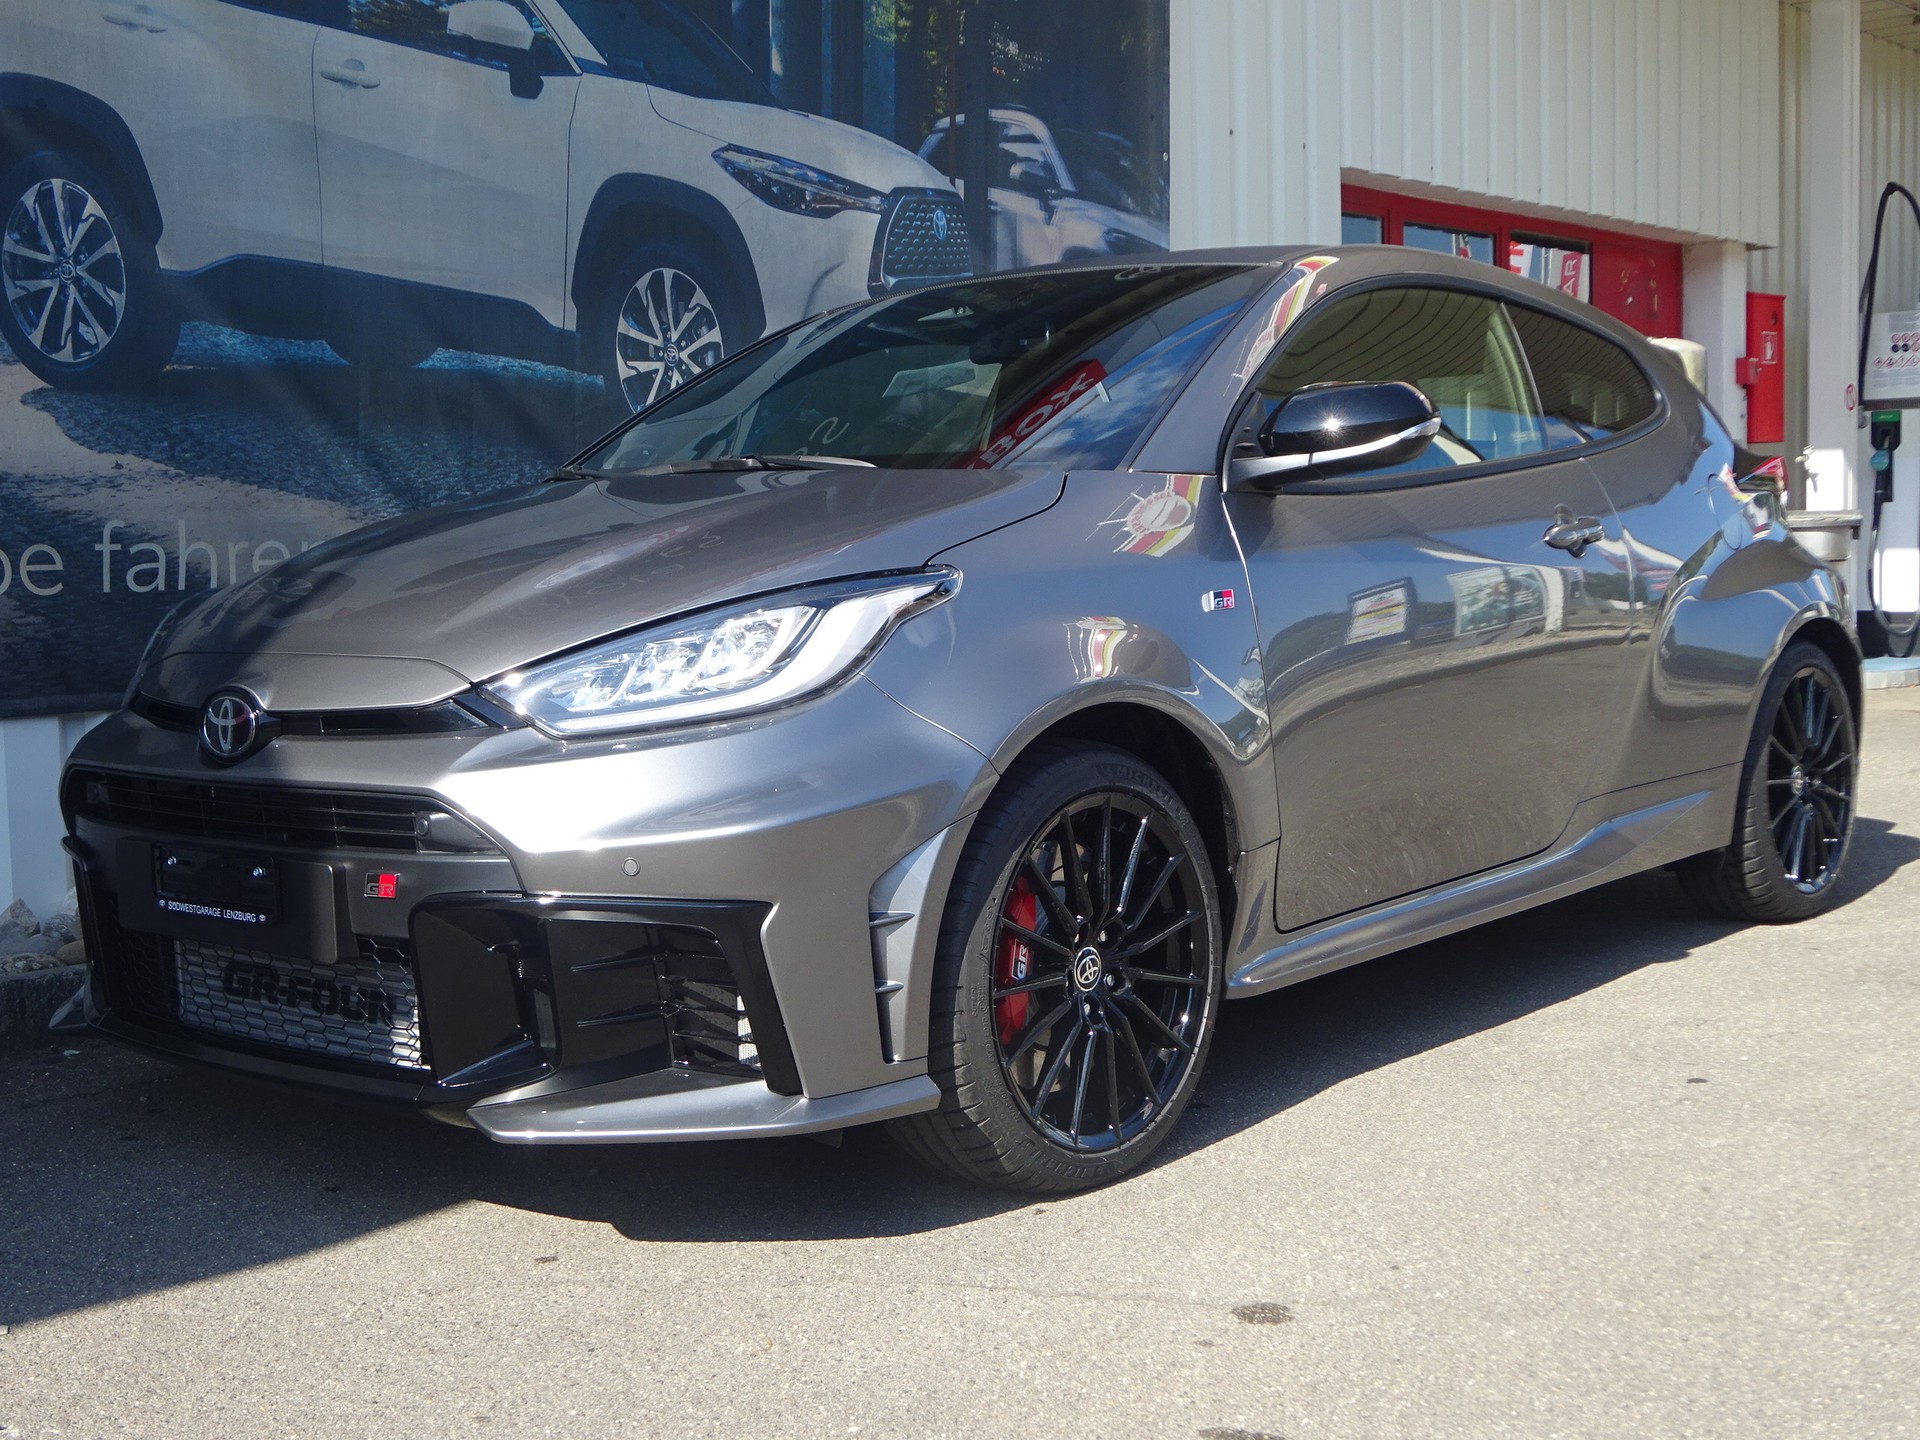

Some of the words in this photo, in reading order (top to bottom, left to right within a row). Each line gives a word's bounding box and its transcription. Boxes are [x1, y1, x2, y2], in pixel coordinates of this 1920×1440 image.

[966, 372, 1095, 470] BOX
[1214, 597, 1233, 608] GR
[366, 882, 394, 896] GR
[223, 909, 257, 923] LENZBURG
[1017, 943, 1028, 979] GR
